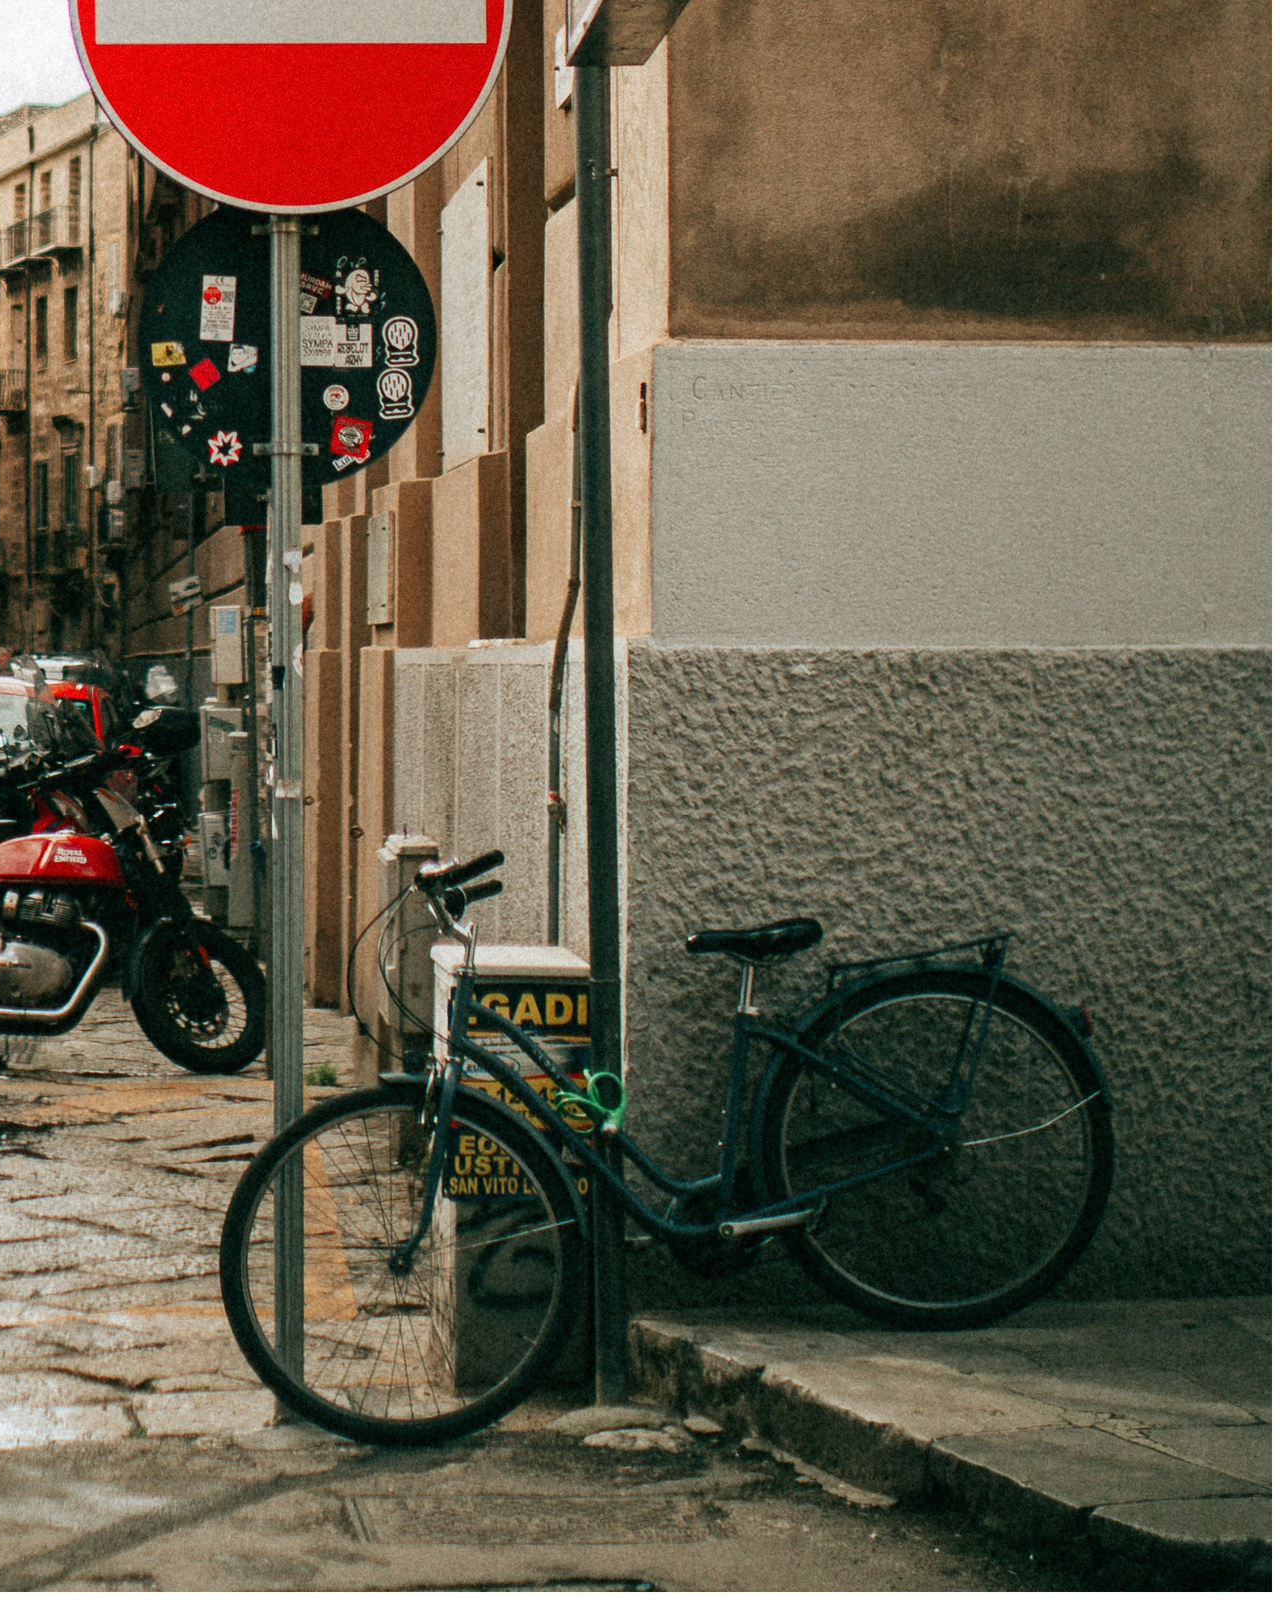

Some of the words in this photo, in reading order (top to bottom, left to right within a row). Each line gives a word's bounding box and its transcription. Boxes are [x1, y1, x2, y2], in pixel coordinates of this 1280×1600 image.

[302, 339, 333, 348] SYMPA
[467, 992, 588, 1026] GADI
[449, 1176, 478, 1195] SAN
[483, 1176, 518, 1195] VITO
